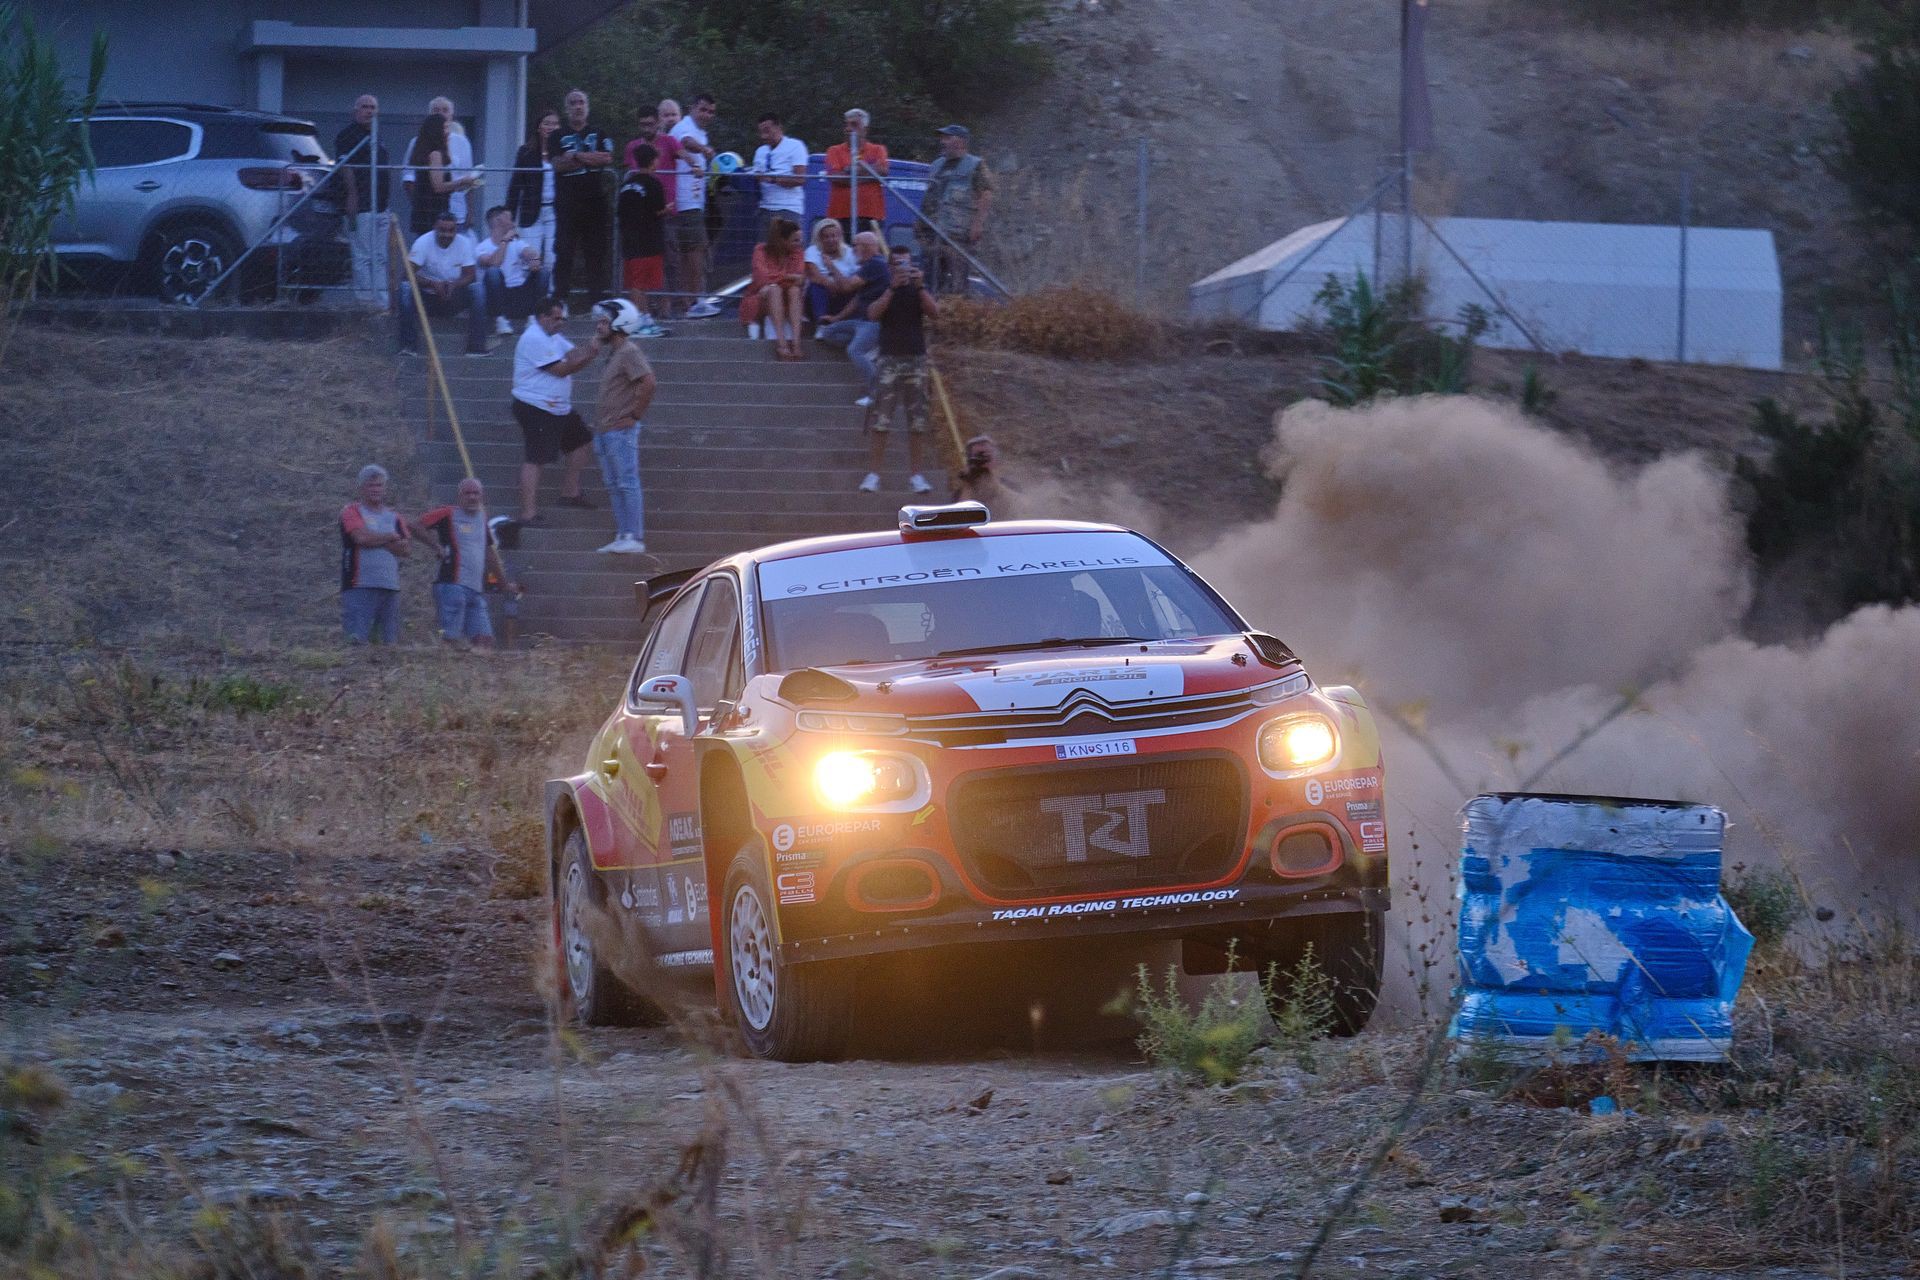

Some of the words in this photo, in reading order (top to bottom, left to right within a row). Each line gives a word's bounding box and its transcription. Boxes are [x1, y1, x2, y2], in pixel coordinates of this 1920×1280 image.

[999, 556, 1140, 574] KARELLIS
[1324, 776, 1379, 792] EUROREPAR
[797, 819, 881, 838] EUROREPAR
[776, 852, 806, 862] Prisma
[992, 907, 1045, 921] TAGAI
[1048, 900, 1116, 916] RACING
[1121, 889, 1240, 909] TECHNOLOGY
